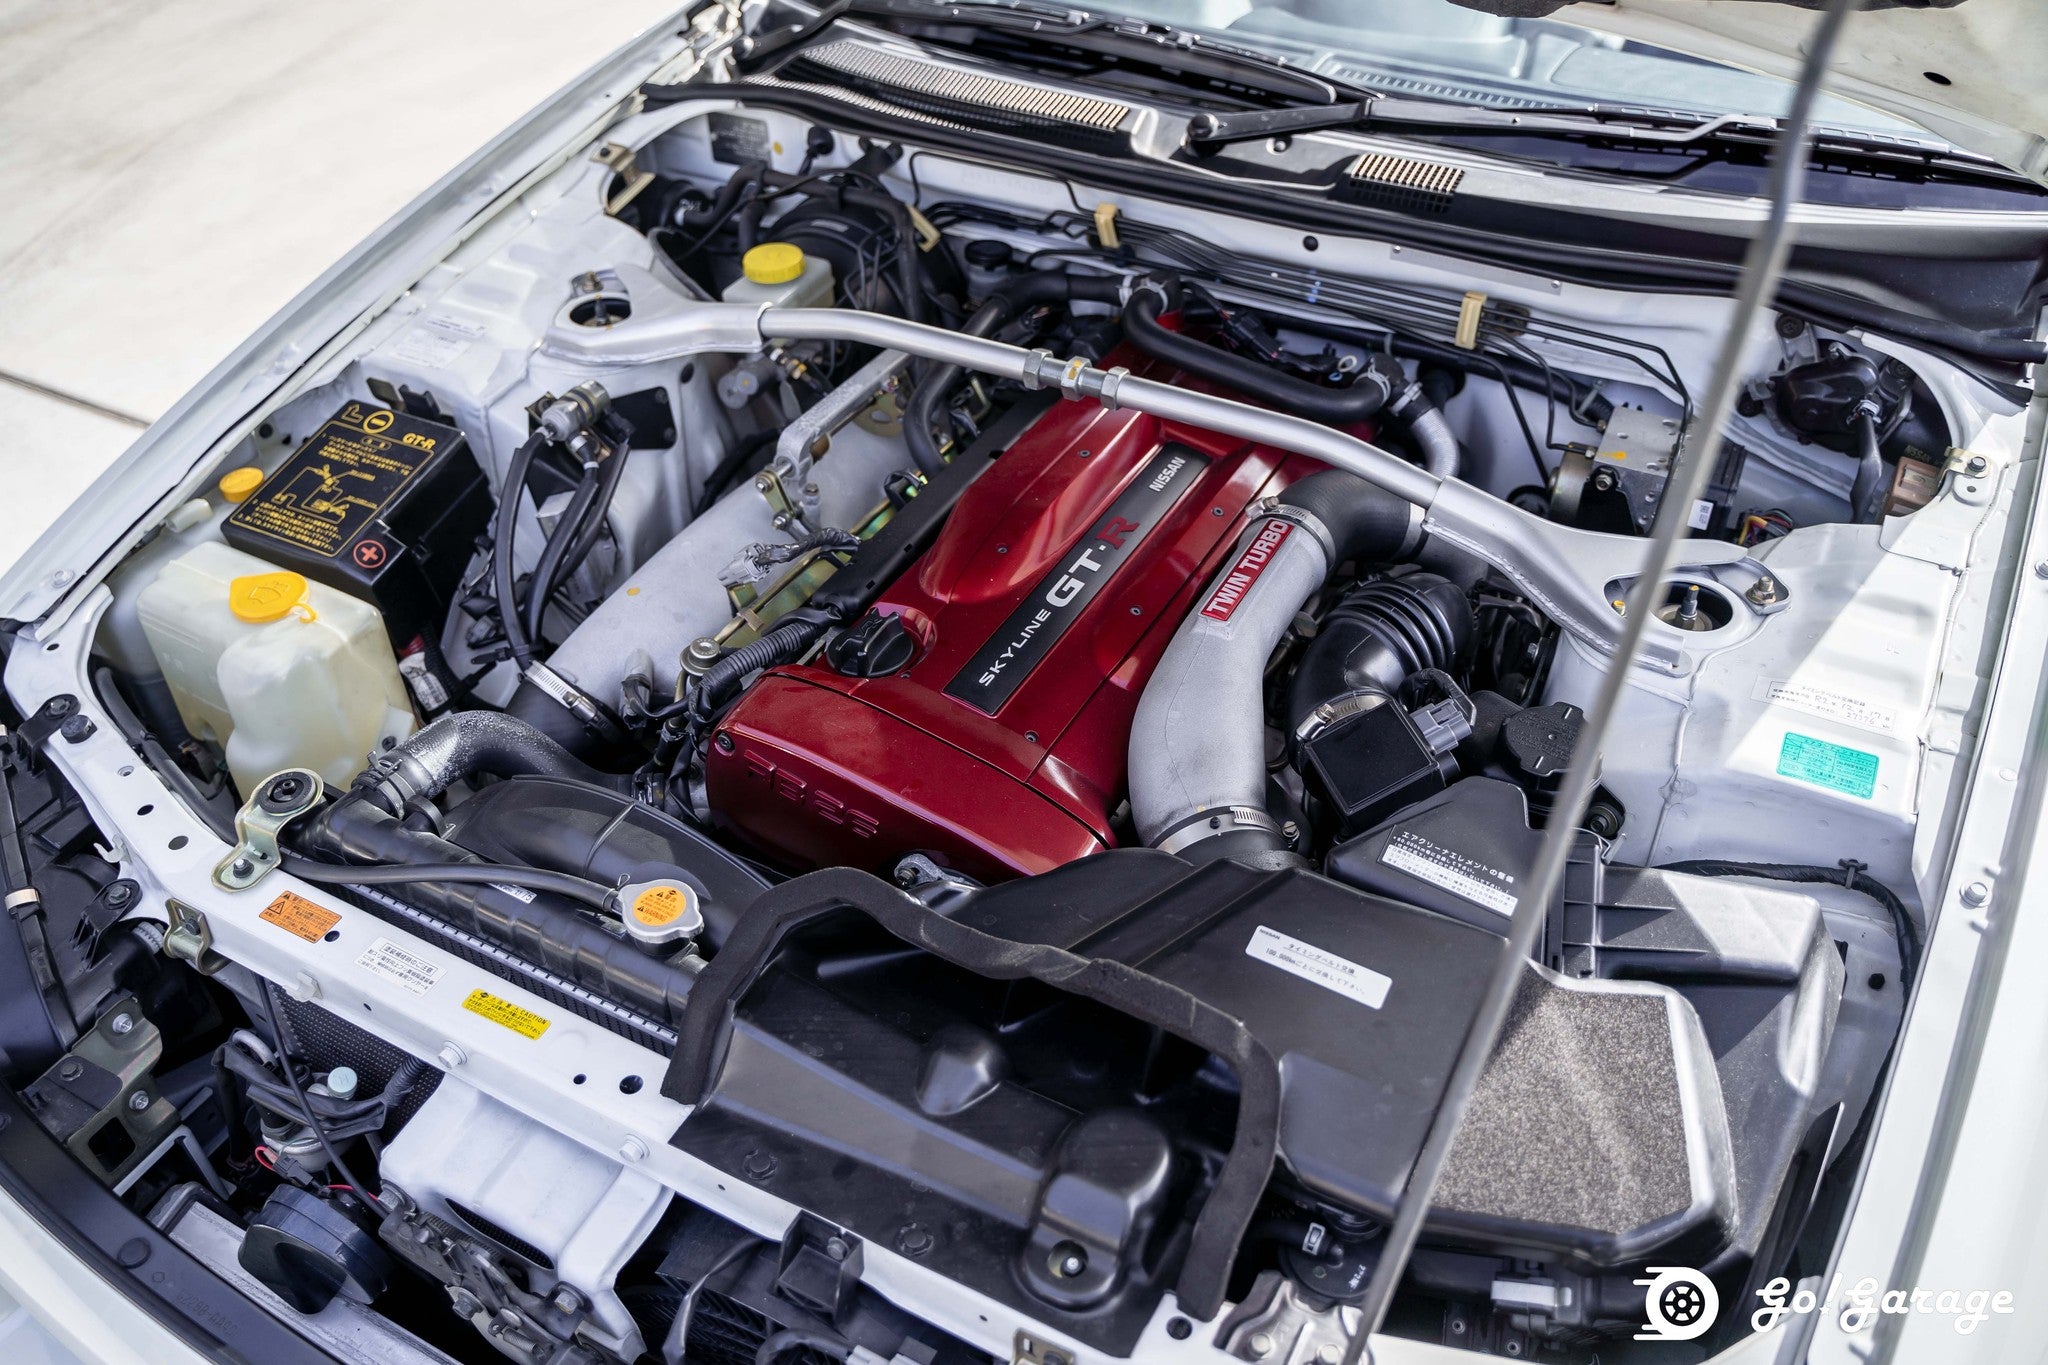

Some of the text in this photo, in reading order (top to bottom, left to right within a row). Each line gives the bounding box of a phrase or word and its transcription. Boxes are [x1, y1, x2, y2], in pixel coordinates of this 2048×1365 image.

[1148, 456, 1186, 492] NISSAN
[1206, 520, 1291, 614] TWIN TURBO
[979, 608, 1051, 687] SKYLINE
[1258, 927, 1282, 941] NISSAN
